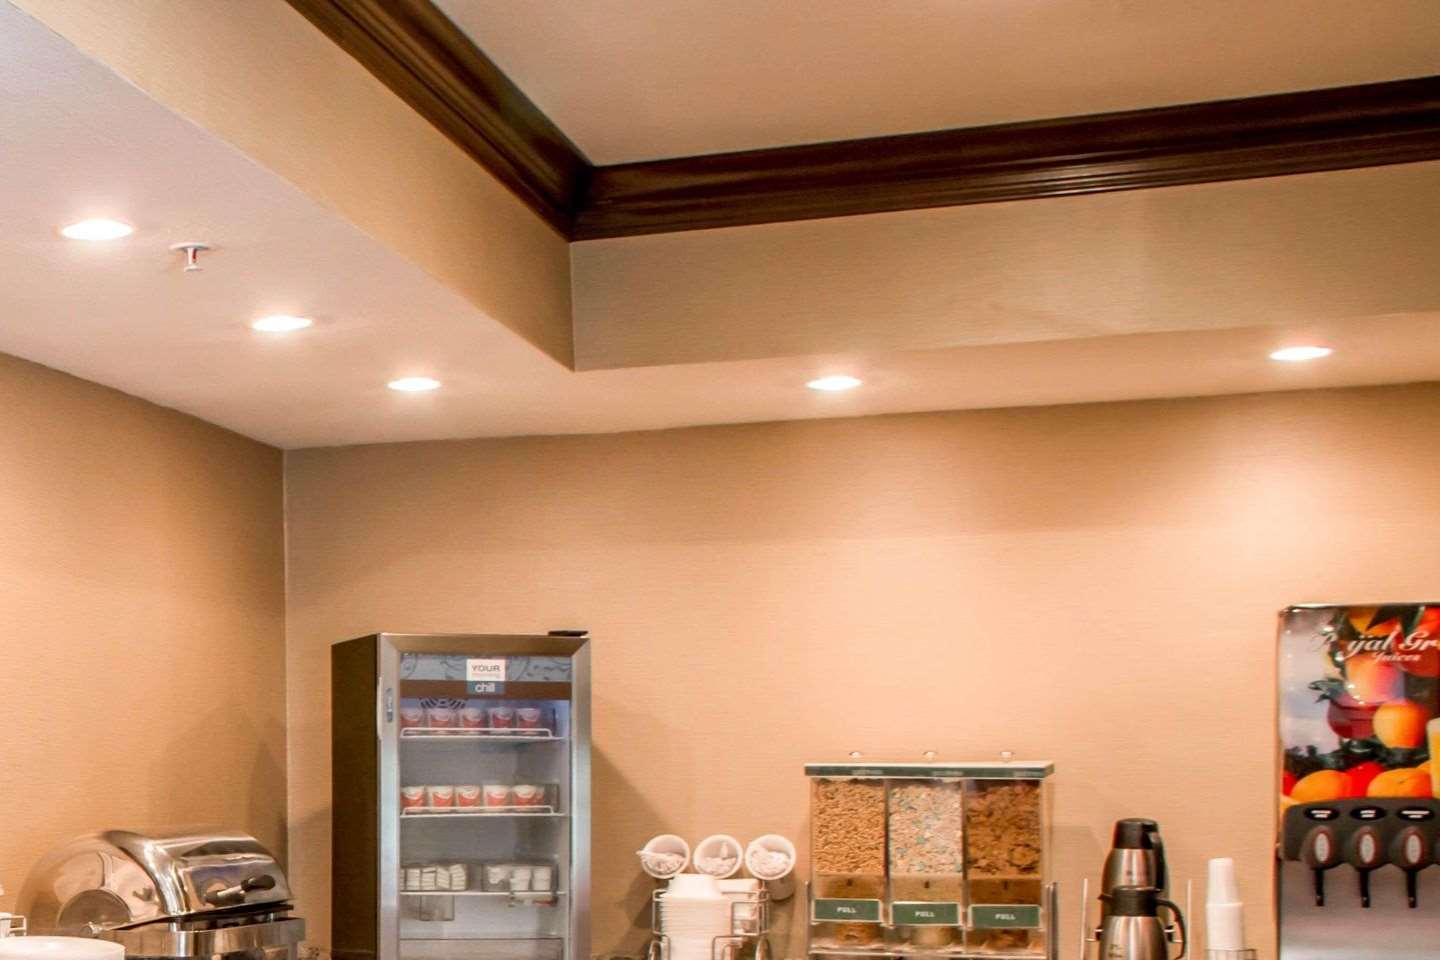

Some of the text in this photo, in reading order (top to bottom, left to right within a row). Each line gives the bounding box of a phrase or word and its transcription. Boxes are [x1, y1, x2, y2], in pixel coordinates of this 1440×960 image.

[1398, 630, 1440, 652] Gr
[471, 664, 501, 672] YOUR
[837, 906, 856, 914] PULL
